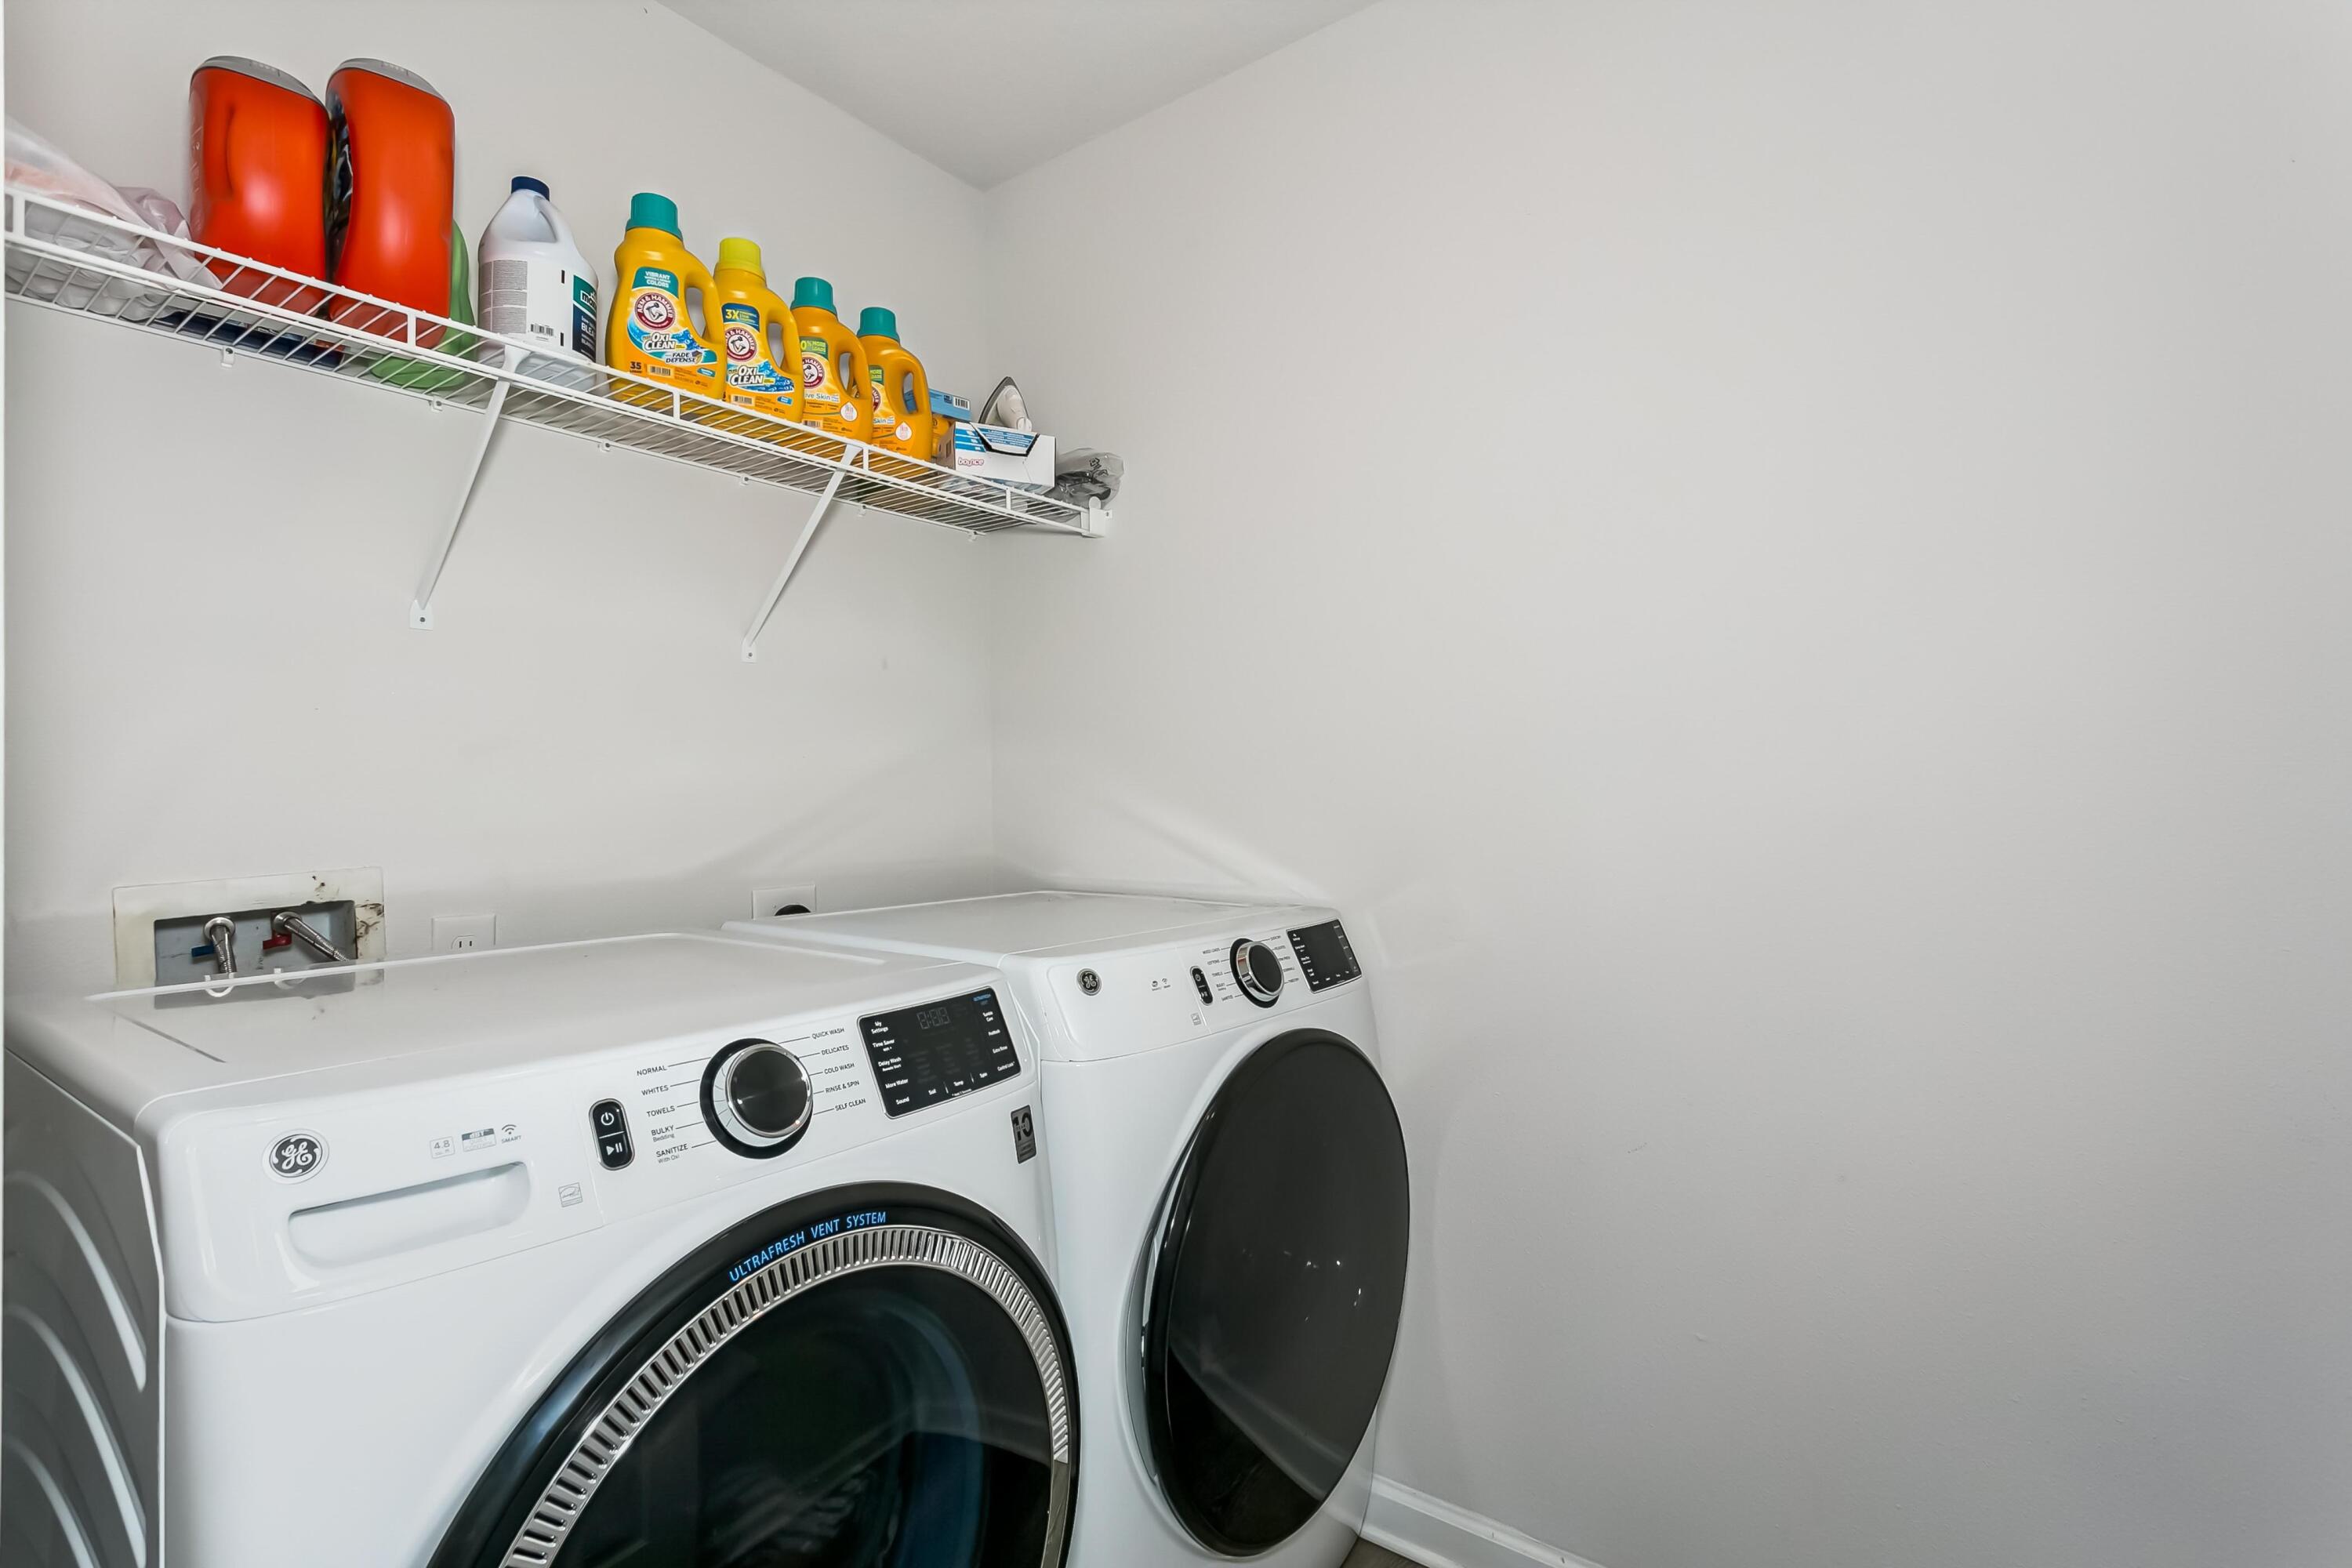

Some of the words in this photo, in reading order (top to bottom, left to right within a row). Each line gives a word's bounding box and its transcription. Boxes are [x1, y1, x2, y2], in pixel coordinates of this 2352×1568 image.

[646, 278, 670, 289] COLORS
[651, 294, 673, 318] HAMMER
[725, 309, 740, 320] 3X
[652, 332, 670, 342] OXI
[735, 329, 755, 350] HAMMER
[644, 340, 676, 350] CLEAN
[630, 361, 641, 370] 35
[739, 365, 758, 376] OXI
[805, 358, 823, 377] HAMMER
[730, 374, 764, 386] CLEAN
[871, 1025, 888, 1034] Settings
[811, 1031, 828, 1040] QUICK
[821, 1044, 850, 1055] DELICATES
[889, 1056, 902, 1065] Wash
[637, 1065, 667, 1076] NORMAL
[895, 1078, 909, 1087] Water
[641, 1085, 669, 1096] WHITES
[826, 1085, 842, 1094] RINSE
[835, 1102, 848, 1111] SELF
[848, 1098, 866, 1107] CLEAN
[895, 1097, 909, 1105] Sound
[647, 1105, 675, 1117] TOWELS
[651, 1125, 674, 1136] BULKY
[501, 1135, 522, 1144] SMART
[652, 1133, 675, 1142] Bedding
[434, 1140, 451, 1149] 4.8
[656, 1144, 688, 1157] SANITIZE
[728, 1230, 806, 1282] ULTRAFRESH
[810, 1218, 840, 1240] VENT
[846, 1211, 887, 1229] SYSTEM
